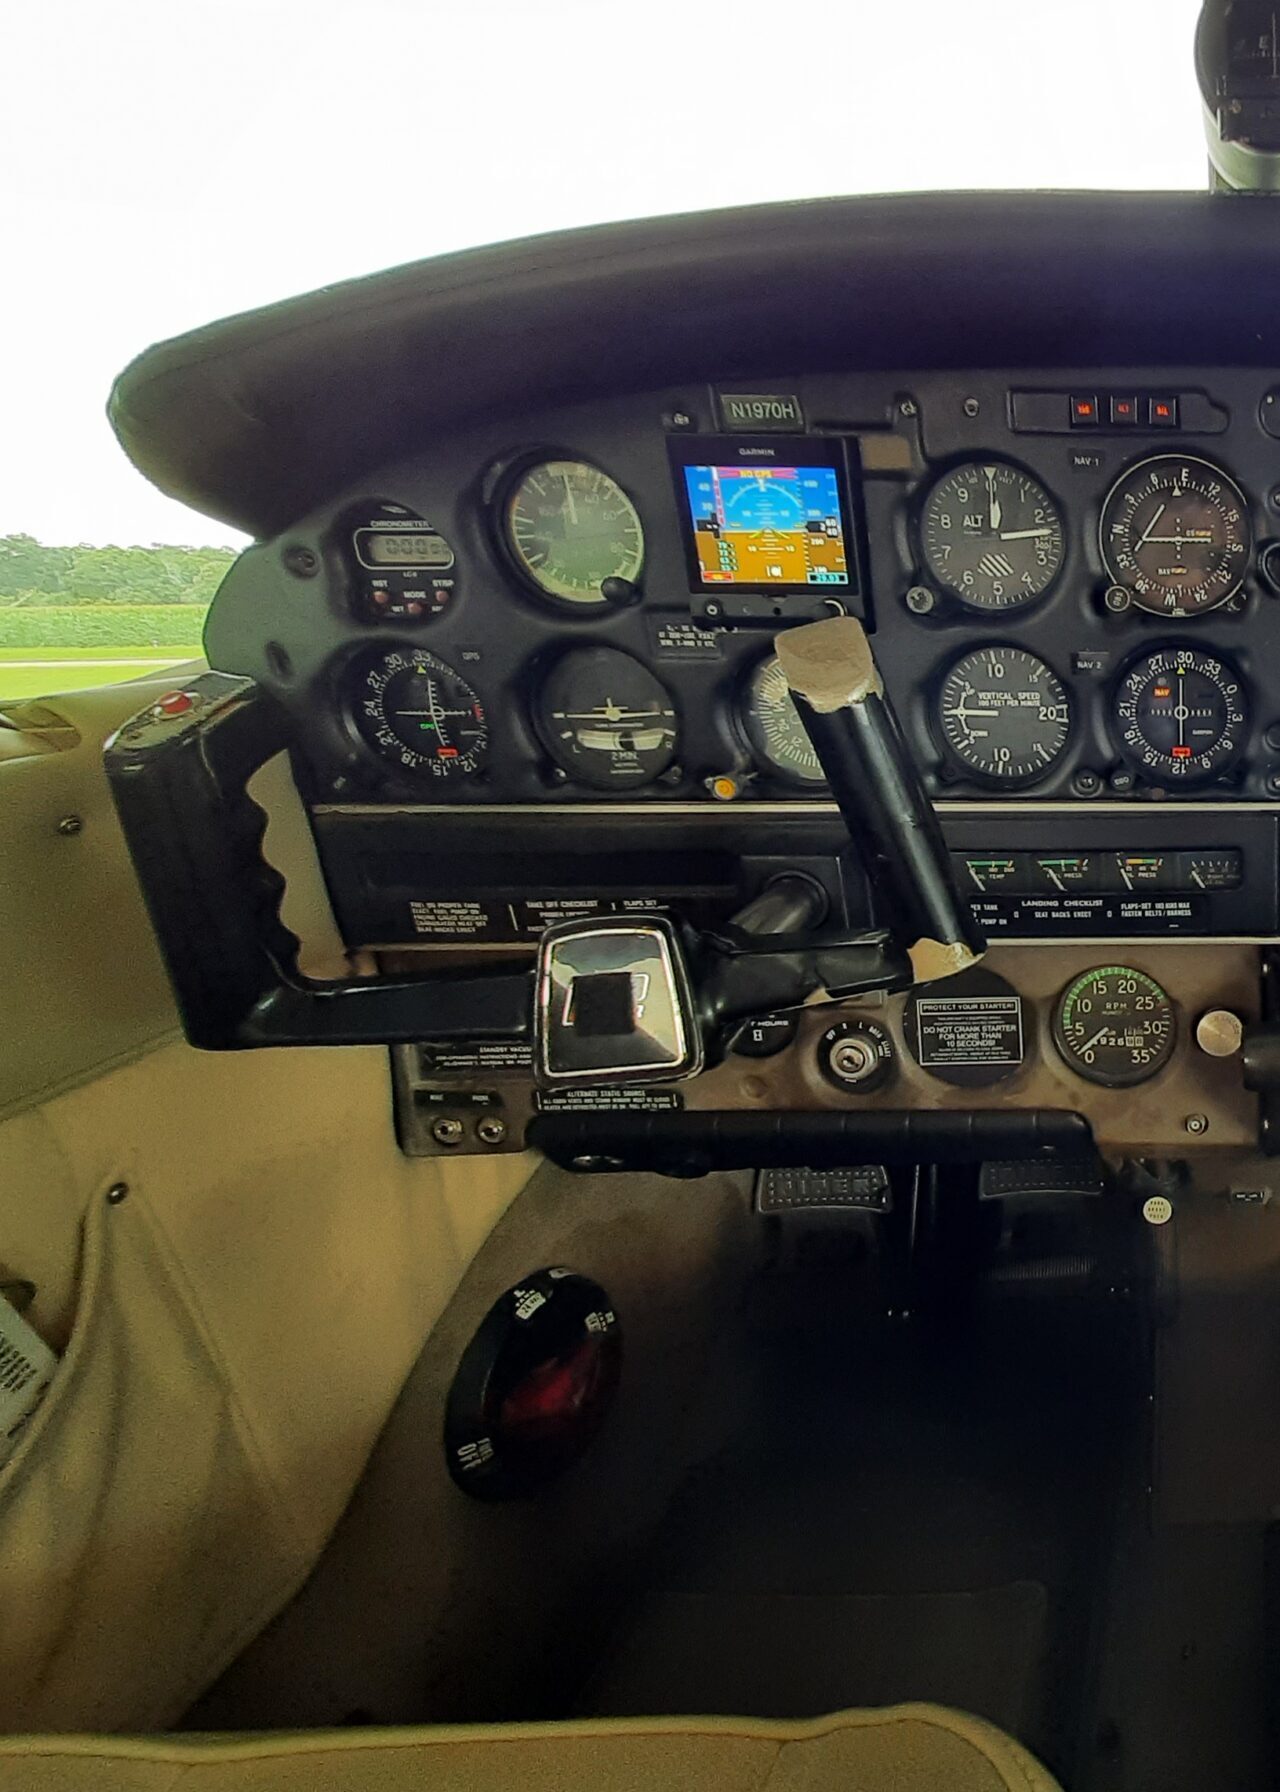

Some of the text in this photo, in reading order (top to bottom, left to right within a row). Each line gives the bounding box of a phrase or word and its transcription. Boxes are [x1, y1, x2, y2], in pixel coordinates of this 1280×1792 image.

[732, 403, 795, 419] N1970H
[739, 448, 775, 456] GARMIN
[1074, 457, 1099, 466] NAV 1
[1182, 469, 1189, 481] E
[958, 488, 968, 502] 9
[1208, 483, 1221, 494] 12
[941, 514, 951, 528] 8
[963, 515, 983, 527] ALT
[1035, 509, 1045, 523] 2
[1228, 509, 1239, 522] 15
[1112, 524, 1124, 534] N
[941, 546, 951, 559] 7
[1037, 552, 1047, 565] 3
[1117, 554, 1129, 568] 33
[963, 571, 973, 584] 6
[1022, 572, 1032, 584] 4
[1218, 572, 1231, 584] 21
[993, 581, 1002, 595] 5
[1135, 580, 1150, 594] 30
[1165, 595, 1176, 606] W
[1195, 590, 1207, 601] 24
[384, 654, 402, 669] 30
[462, 652, 480, 660] GPS
[1149, 655, 1164, 670] 27
[1177, 651, 1193, 663] 30
[988, 663, 1004, 677] 10
[1077, 661, 1094, 669] NAV
[1205, 659, 1222, 674] 33
[367, 671, 381, 688] 27
[1029, 675, 1038, 683] 15
[1127, 673, 1142, 690] 24
[1227, 685, 1238, 694] 0
[364, 701, 379, 716] 24
[1039, 707, 1056, 720] 20
[1119, 702, 1131, 716] 21
[1233, 713, 1243, 722] 3
[376, 730, 392, 745] 21
[1124, 730, 1137, 746] 18
[1033, 743, 1042, 752] 15
[1223, 740, 1233, 750] 6
[401, 753, 416, 767] 18
[994, 748, 1010, 761] 10
[1143, 752, 1160, 766] 15
[461, 759, 477, 772] 12
[1172, 763, 1186, 774] 12
[1201, 758, 1211, 768] 9
[433, 765, 448, 776] 15
[1093, 981, 1107, 994] 15
[1118, 980, 1136, 993] 20
[1077, 999, 1092, 1012] 10
[1106, 1002, 1127, 1010] RPM
[1135, 997, 1154, 1010] 25
[826, 1029, 836, 1040] OFF
[1075, 1022, 1084, 1035] 5
[1143, 1021, 1162, 1035] 30
[881, 1040, 891, 1057] START
[1085, 1050, 1094, 1063] 0
[1131, 1049, 1150, 1063] 35
